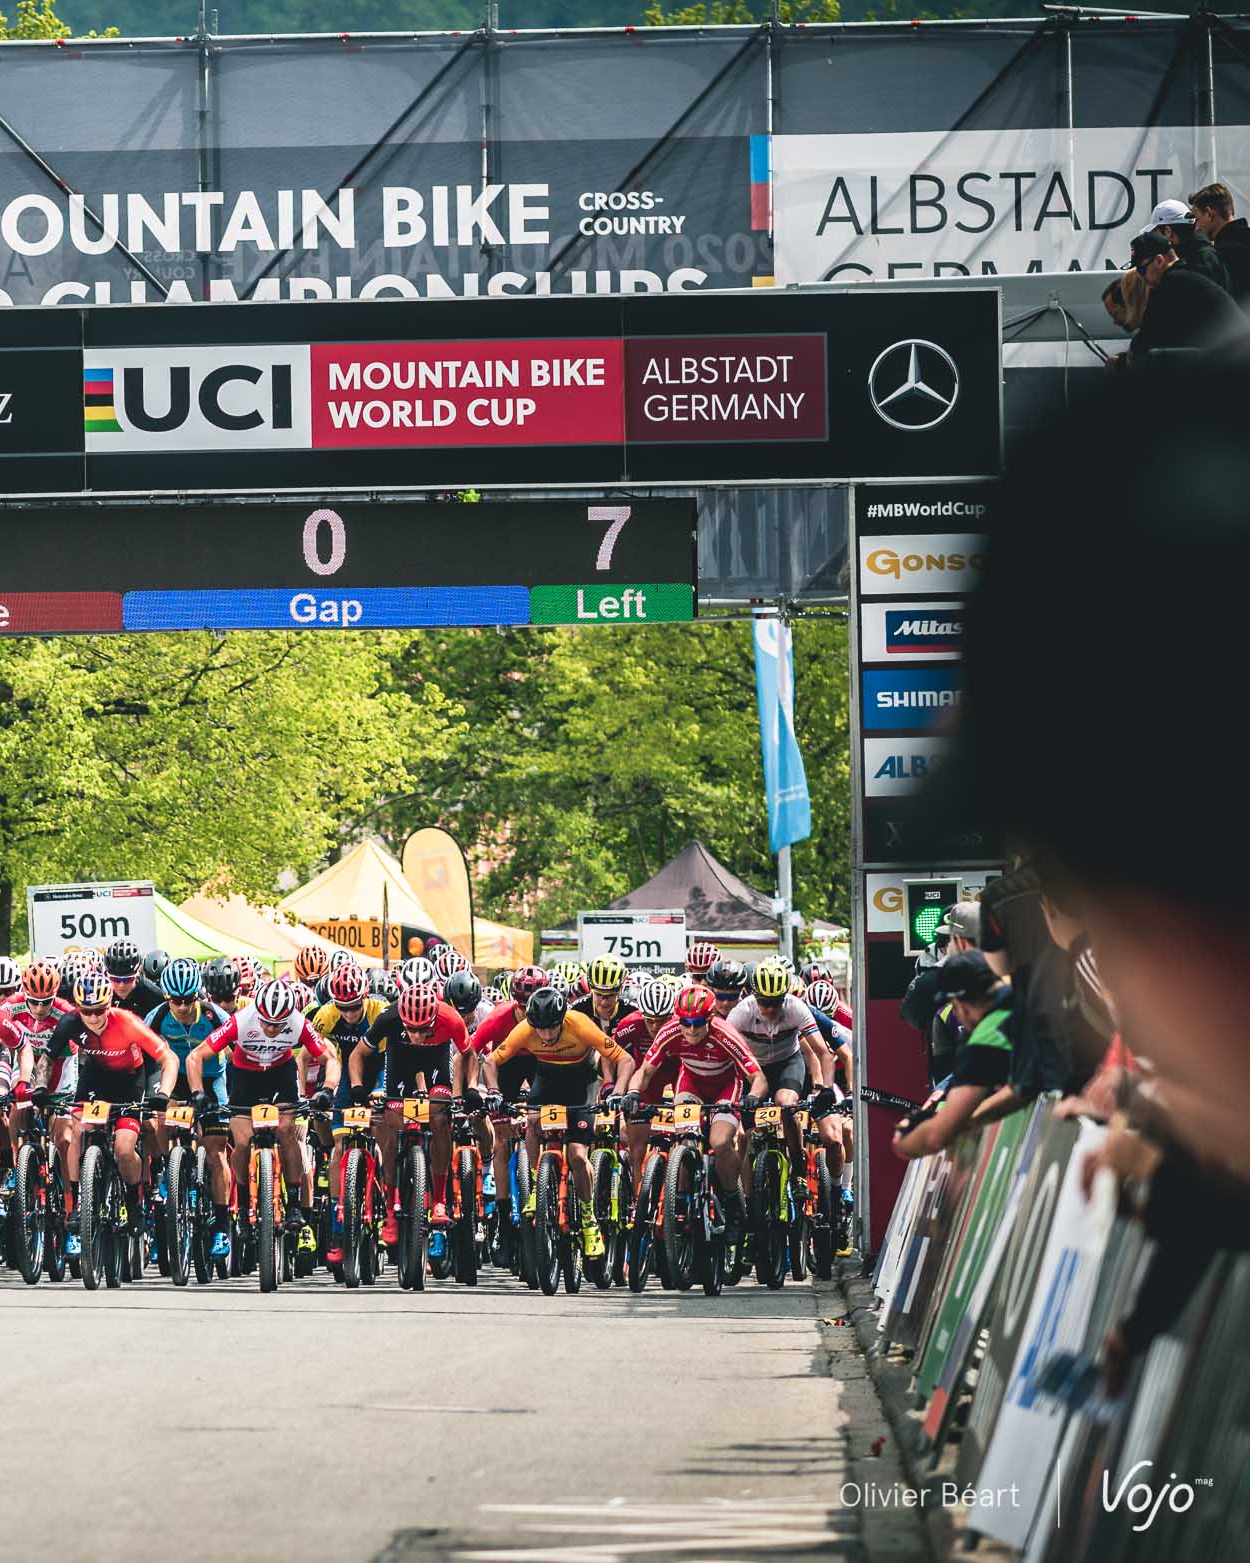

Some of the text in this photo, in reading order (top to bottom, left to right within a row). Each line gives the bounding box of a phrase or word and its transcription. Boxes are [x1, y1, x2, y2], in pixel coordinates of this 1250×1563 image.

[578, 191, 664, 211] CROSS-
[816, 168, 1174, 237] ALBSTADT
[382, 182, 550, 248] BIKE
[578, 215, 686, 236] COUNTRY
[328, 357, 606, 390] MOUNTAIN BIKE
[642, 355, 794, 387] ALBSTADT
[123, 363, 292, 433] UCI
[643, 392, 805, 423] GERMANY
[328, 398, 537, 429] WORLD CUP
[302, 508, 347, 576] 0
[587, 506, 632, 571] 7
[288, 593, 363, 630] Gap
[577, 587, 646, 619] Left
[60, 913, 130, 939] 50m
[604, 936, 661, 957] 75m
[92, 1104, 100, 1117] 4
[173, 1110, 187, 1120] 11
[260, 1107, 269, 1118] 7
[350, 1109, 367, 1119] 14
[412, 1104, 420, 1117] 1
[549, 1108, 558, 1121] 5
[683, 1107, 692, 1119] 8
[759, 1109, 777, 1119] 20
